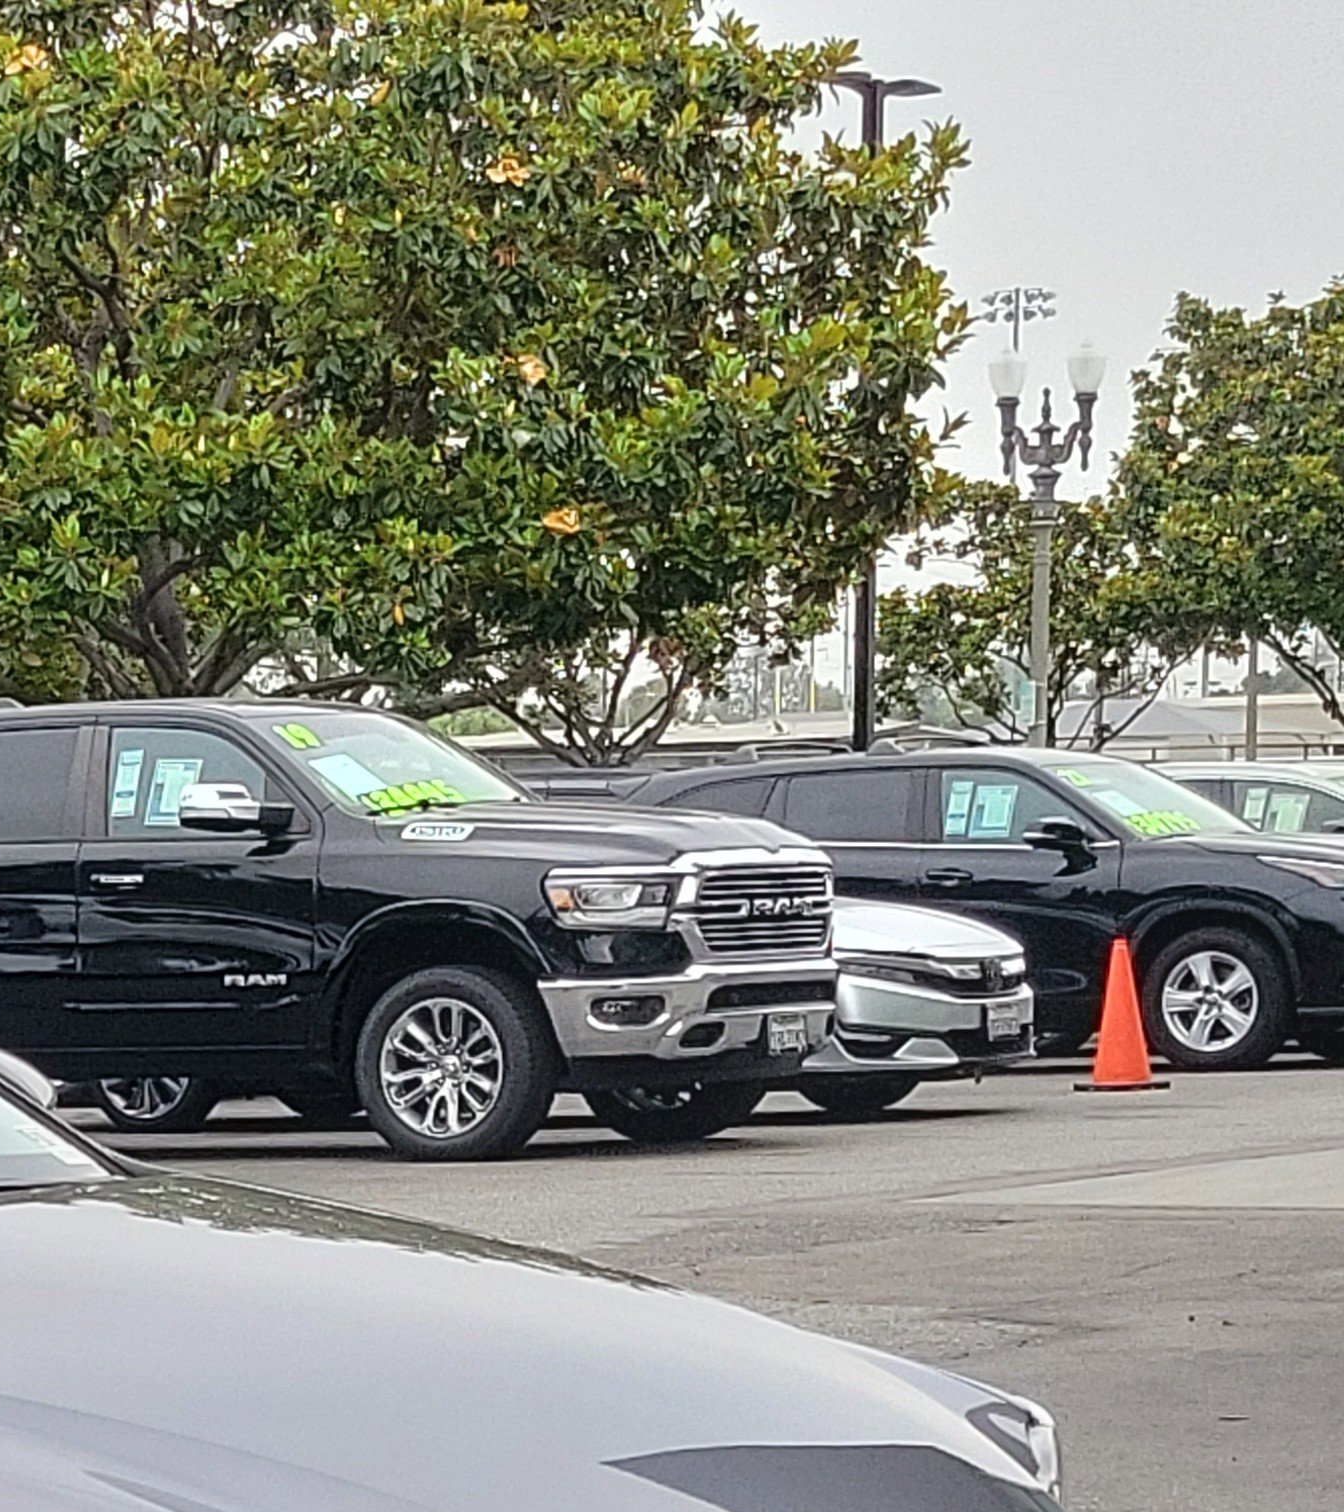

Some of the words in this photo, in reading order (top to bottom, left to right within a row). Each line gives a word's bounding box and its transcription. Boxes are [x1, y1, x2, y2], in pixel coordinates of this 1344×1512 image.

[272, 723, 322, 750] 19
[752, 897, 814, 916] RAM
[223, 974, 287, 987] RAM
